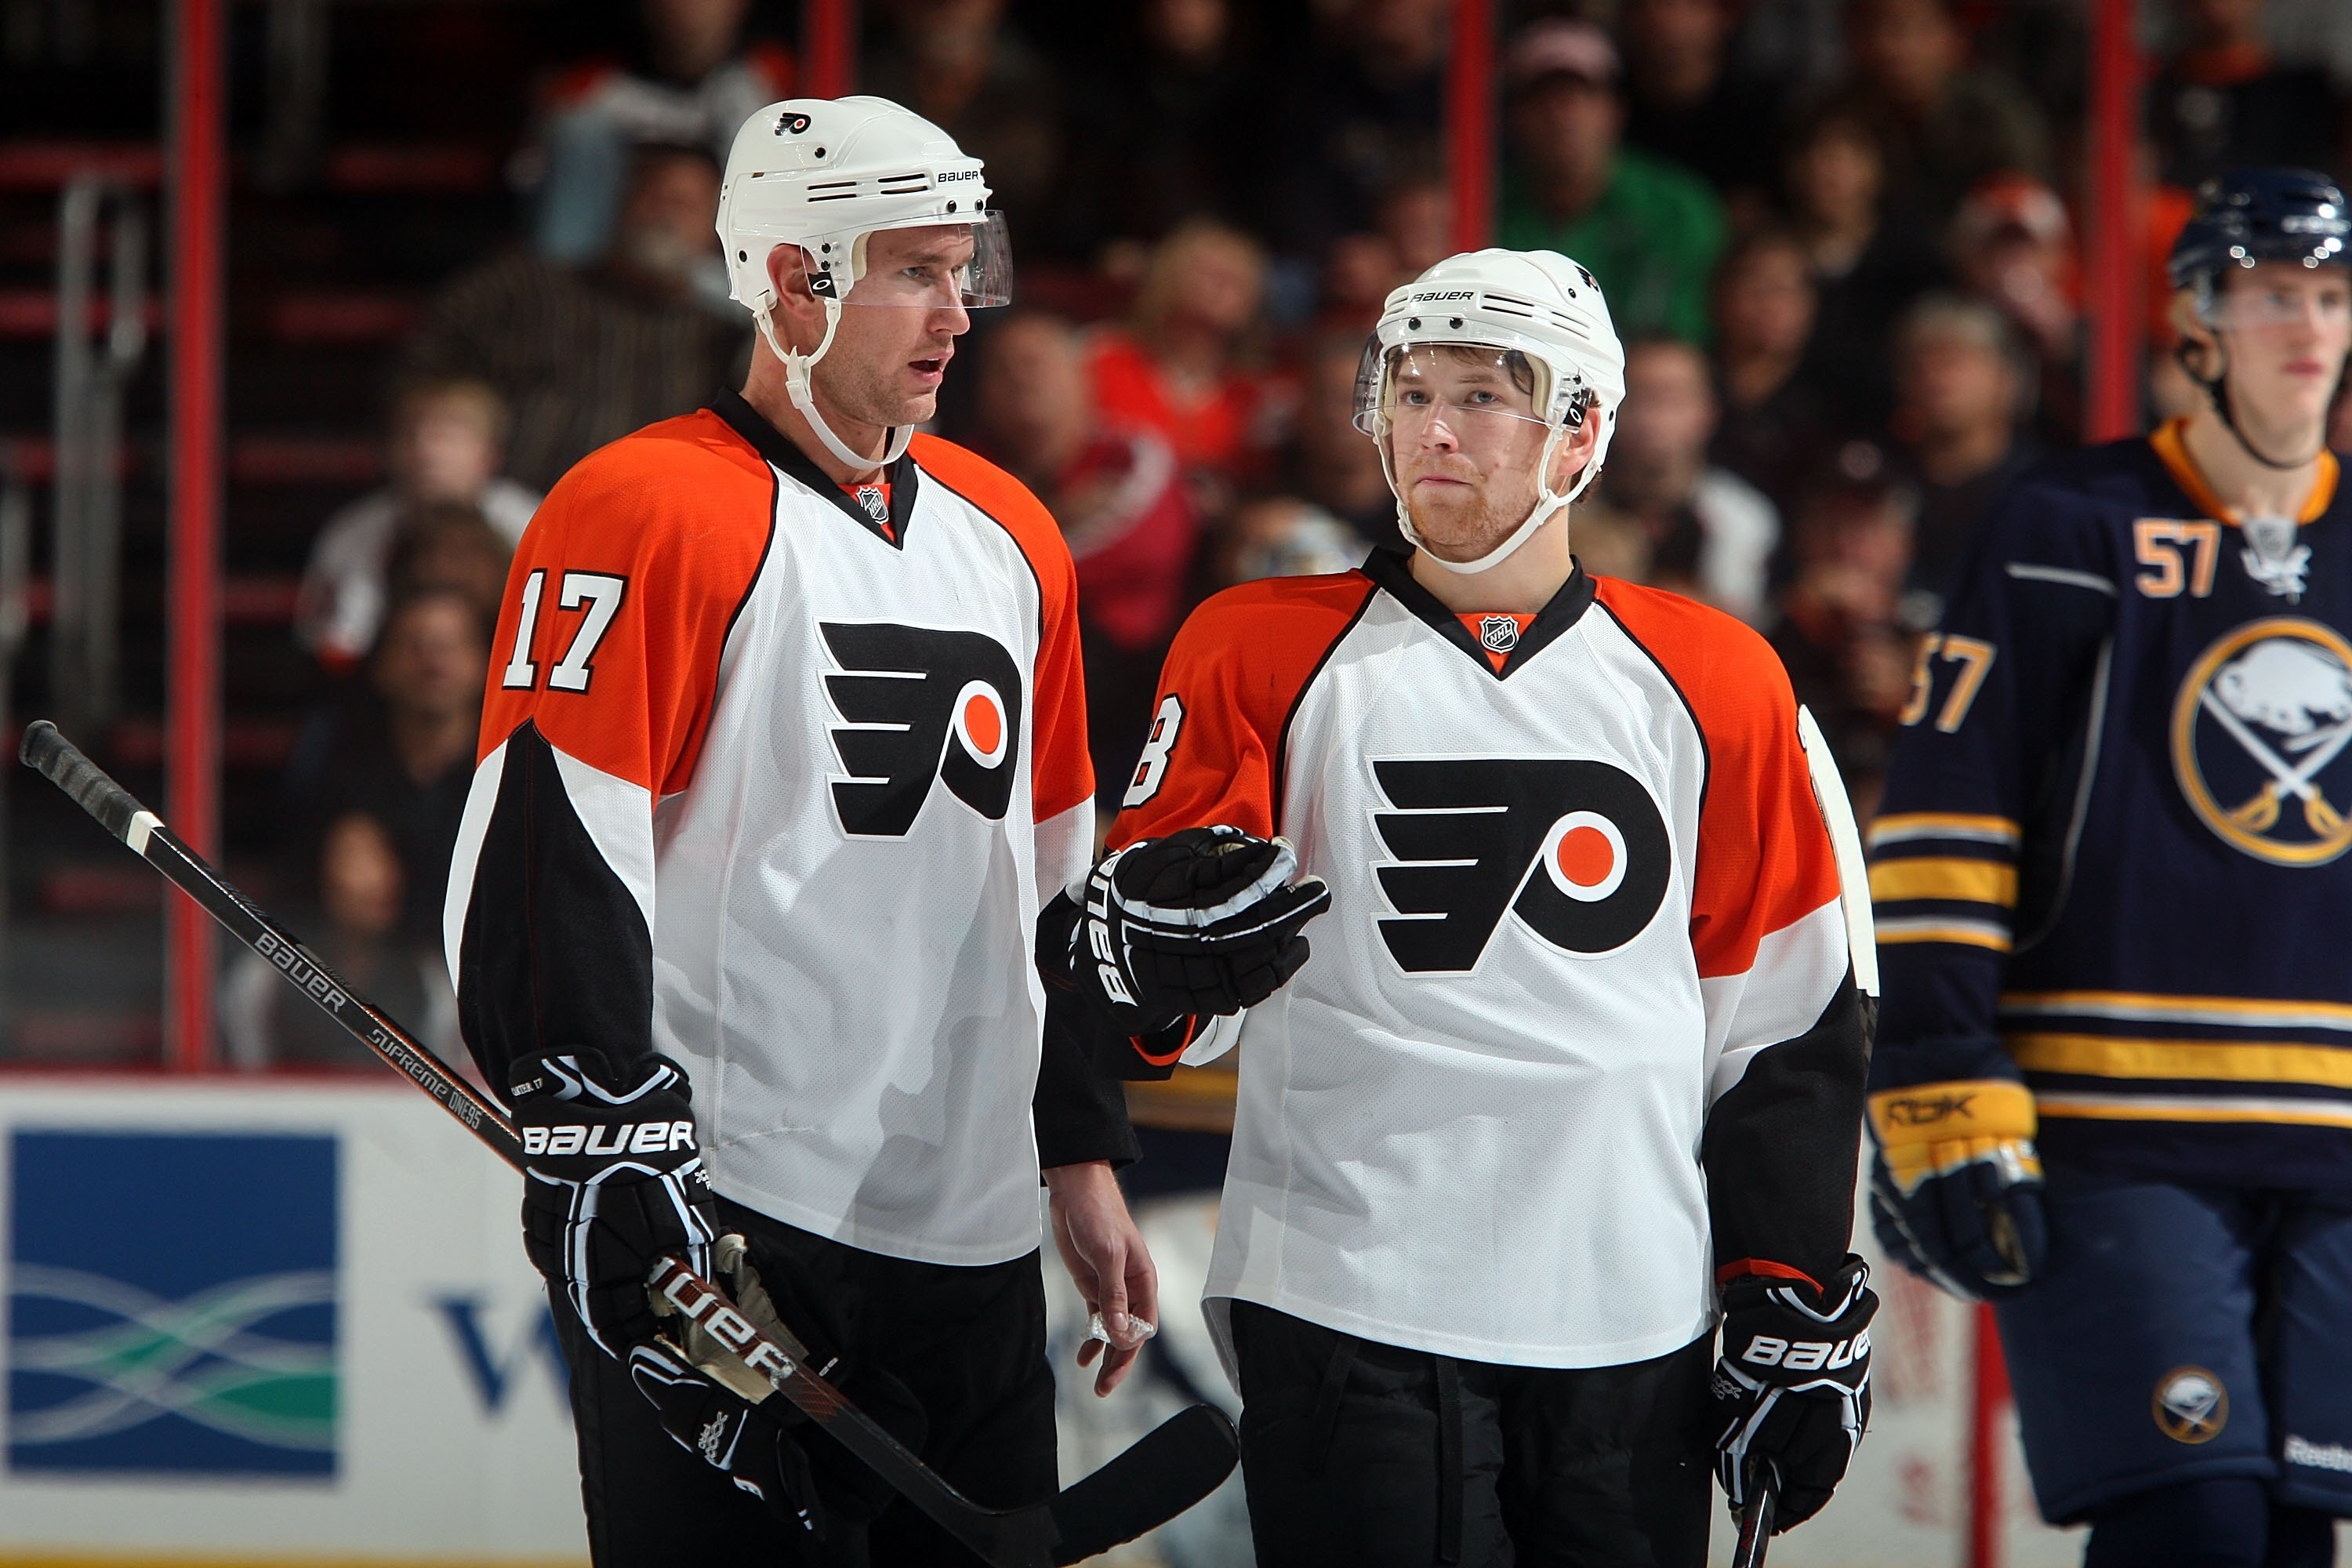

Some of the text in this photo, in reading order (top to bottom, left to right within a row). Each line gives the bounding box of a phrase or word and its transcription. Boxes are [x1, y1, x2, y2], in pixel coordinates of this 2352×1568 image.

[937, 170, 979, 183] BAUER
[867, 495, 882, 517] NHL
[2132, 517, 2221, 598] 57
[502, 568, 630, 696] 17
[1489, 625, 1512, 644] NHL
[1120, 693, 1186, 811] 8
[1087, 850, 1138, 1007] BAUE
[253, 932, 347, 1013] BAUER
[365, 1028, 448, 1099] SUPREME
[522, 1120, 696, 1156] BAUER
[1741, 1329, 1871, 1370] BAUE
